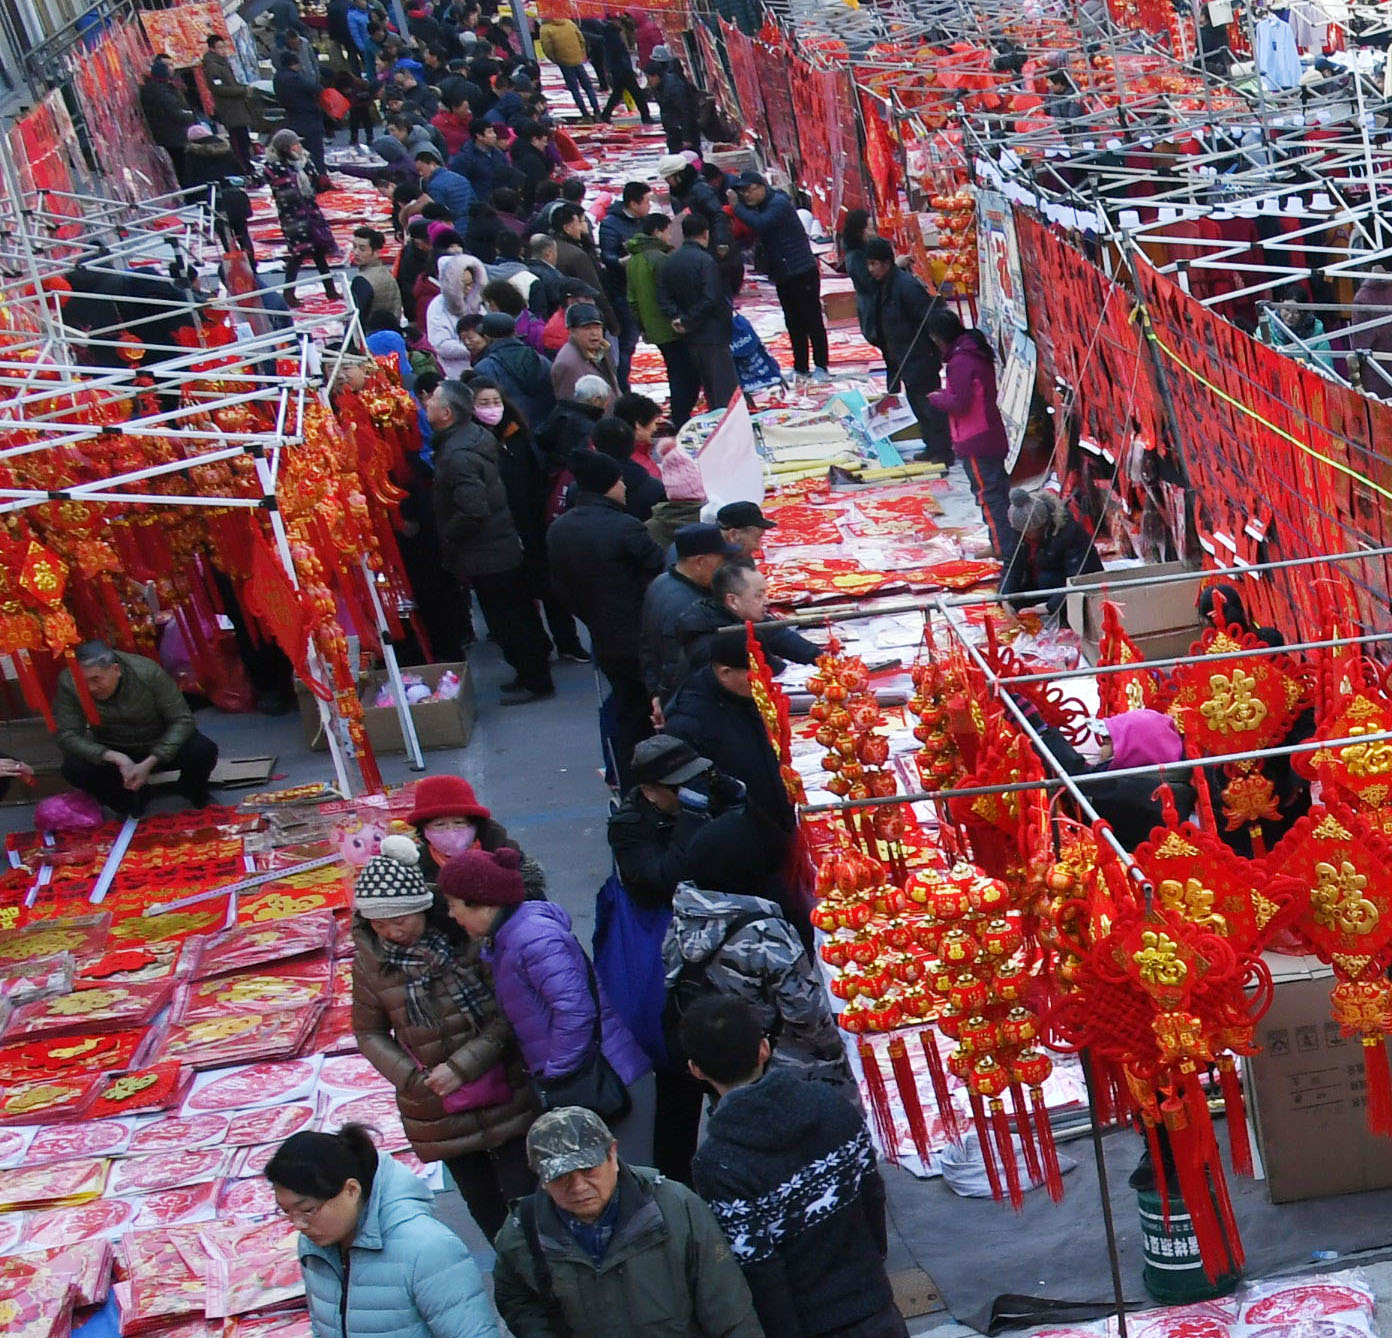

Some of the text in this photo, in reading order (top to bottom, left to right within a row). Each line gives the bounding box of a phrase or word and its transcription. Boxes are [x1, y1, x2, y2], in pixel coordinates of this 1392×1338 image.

[1200, 668, 1269, 735] 福
[1310, 860, 1380, 934] 福
[1133, 929, 1189, 985] 福
